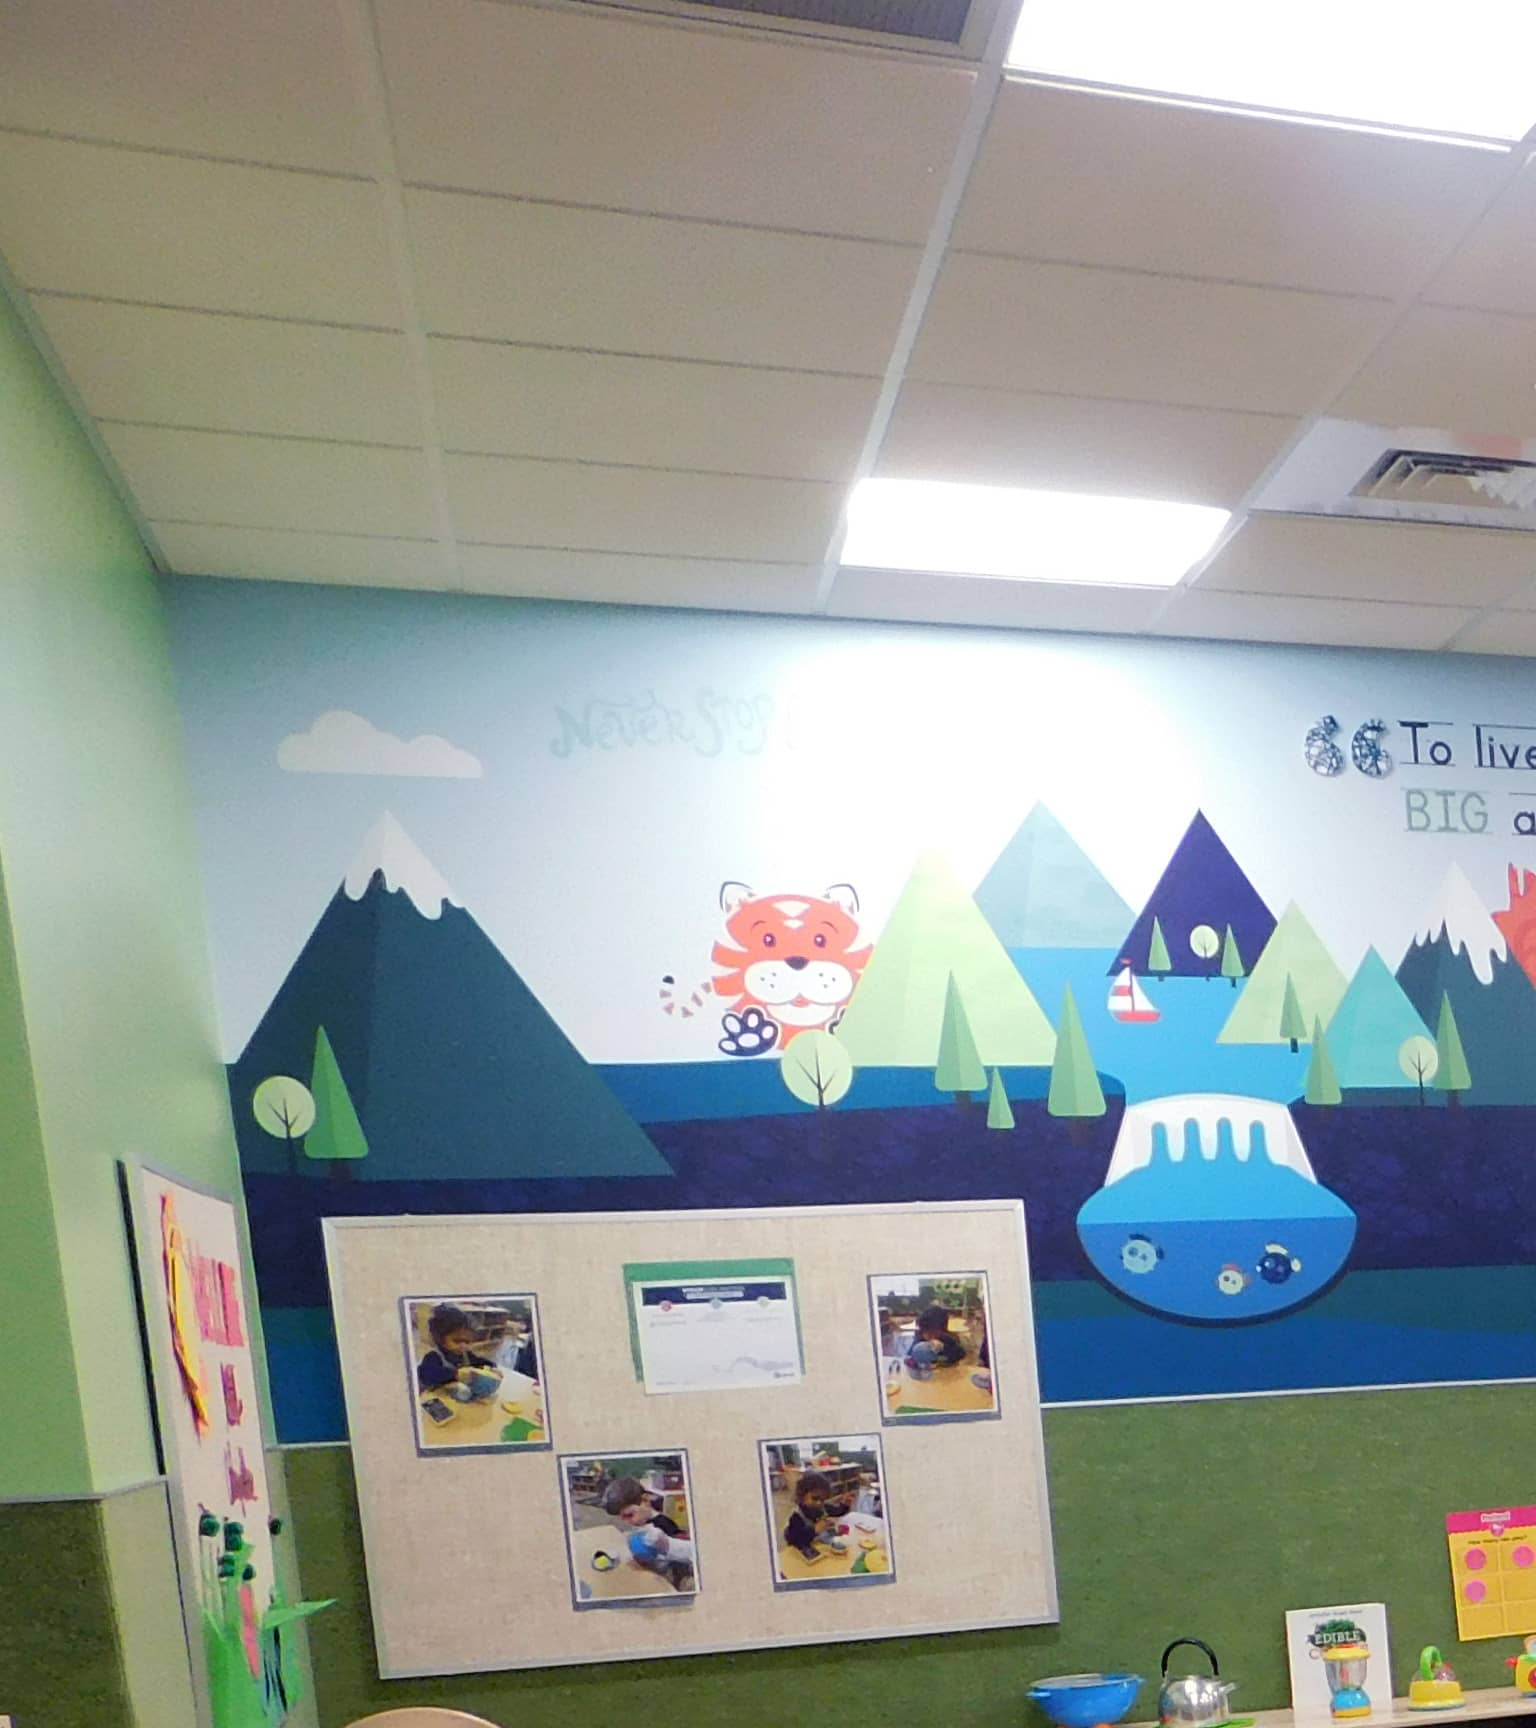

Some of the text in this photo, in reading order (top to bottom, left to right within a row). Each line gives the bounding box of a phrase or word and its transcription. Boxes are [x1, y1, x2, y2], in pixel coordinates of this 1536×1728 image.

[1398, 720, 1454, 766] To
[1404, 788, 1490, 834] BIG
[1314, 1631, 1361, 1645] EDIBLE
